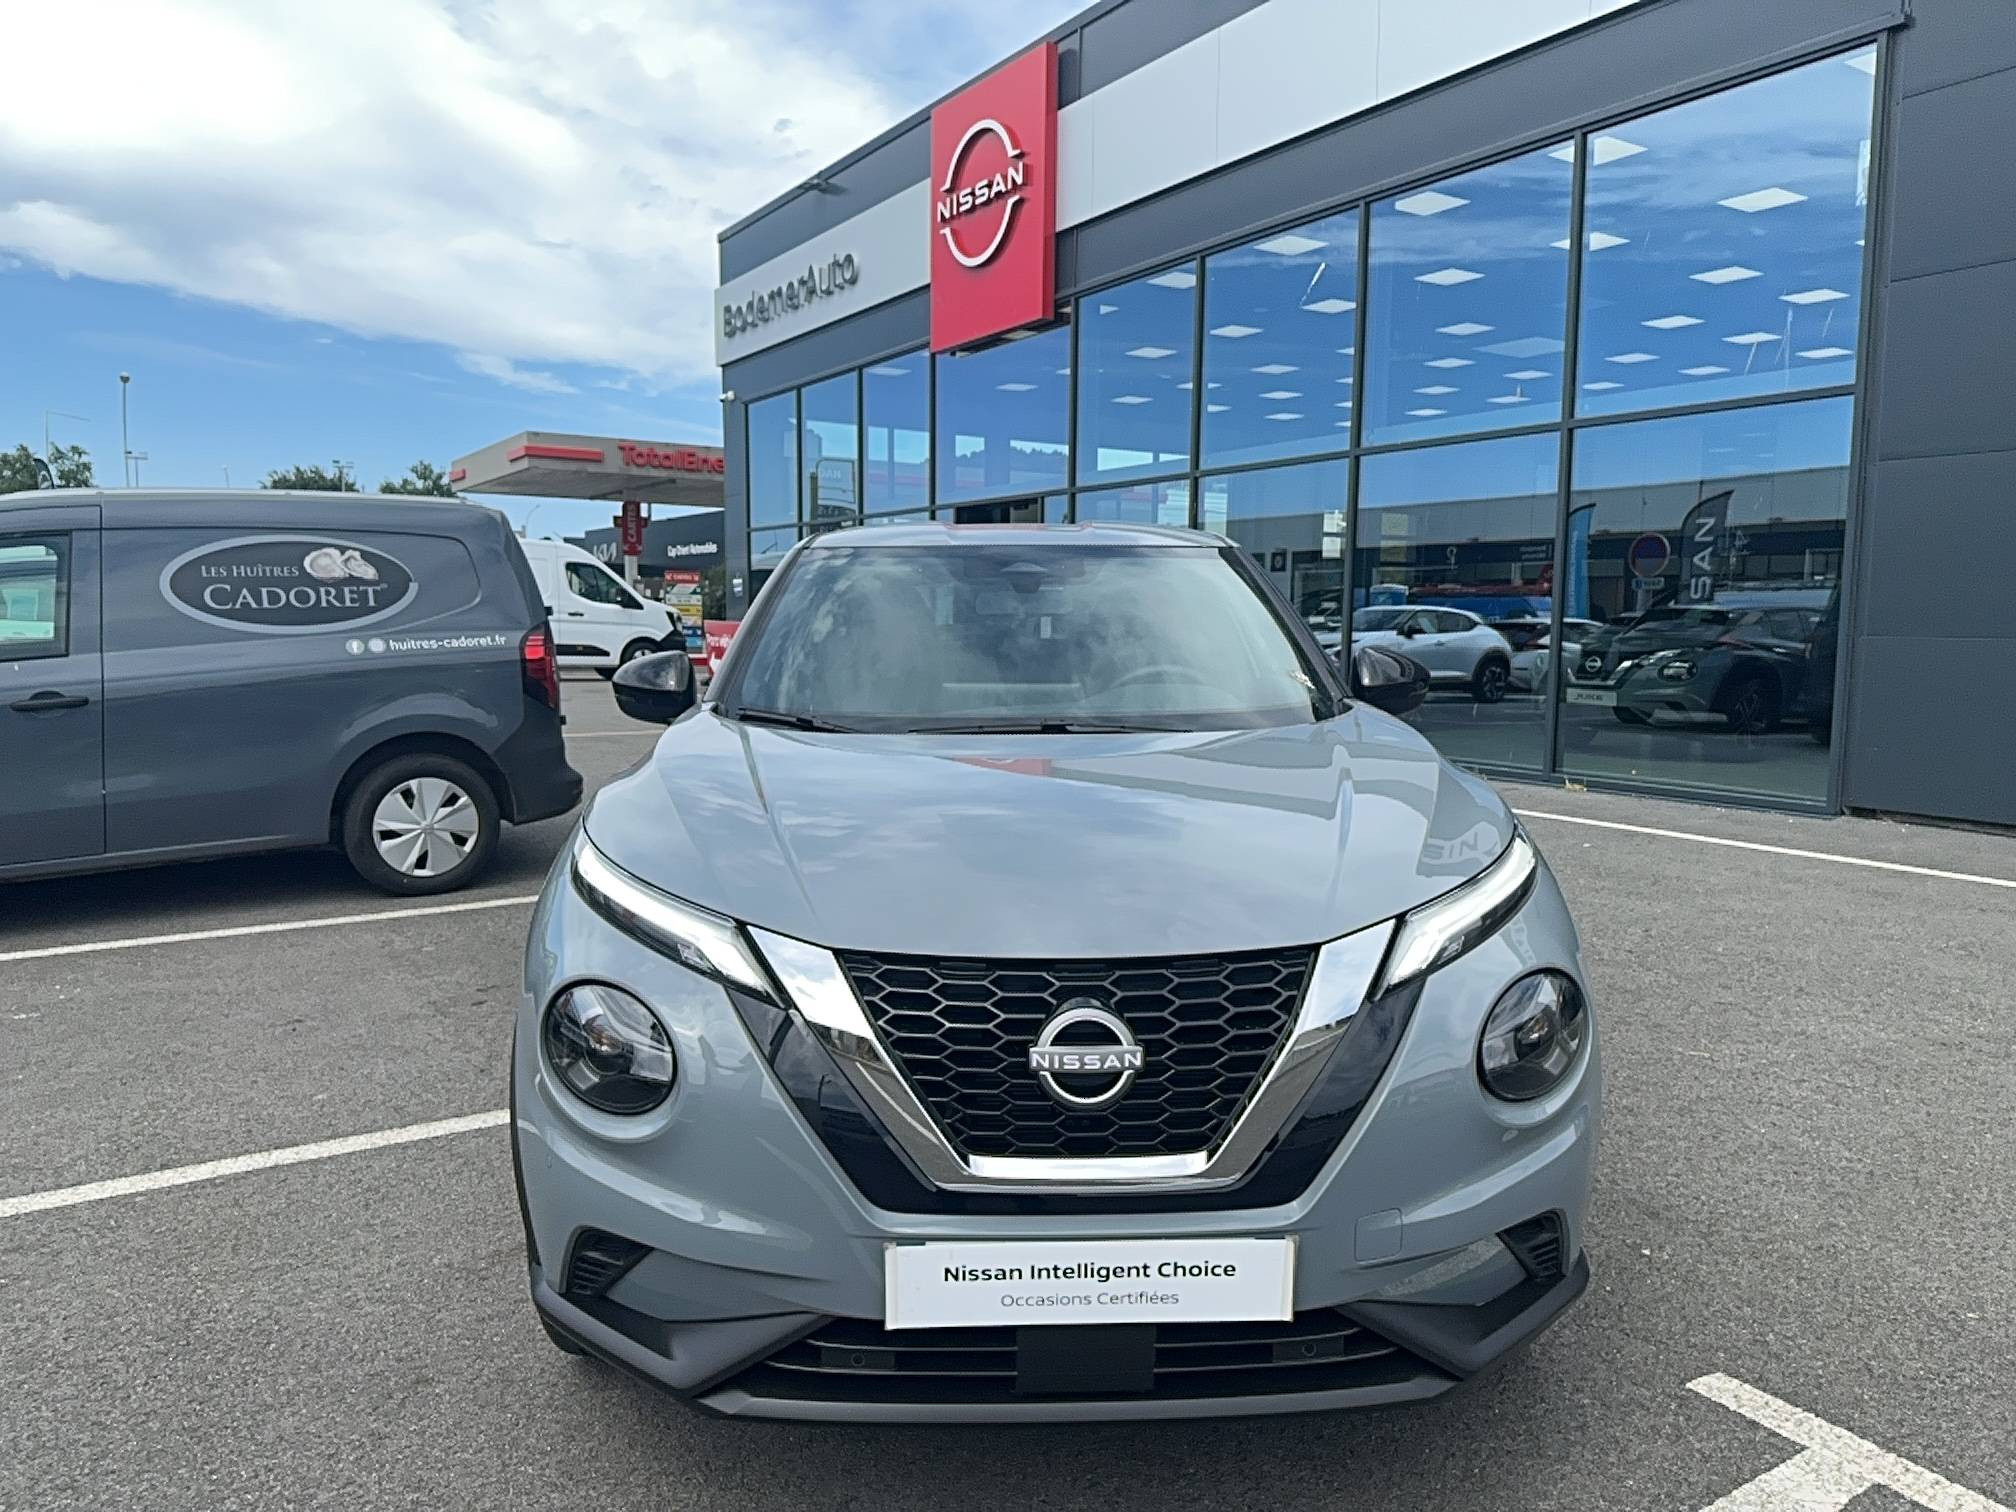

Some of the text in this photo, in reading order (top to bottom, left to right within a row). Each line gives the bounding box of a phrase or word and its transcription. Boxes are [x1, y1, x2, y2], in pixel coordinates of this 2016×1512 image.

[936, 161, 1025, 222] NISSAN
[201, 564, 227, 578] LES
[203, 583, 381, 610] CADORET
[1031, 1052, 1142, 1070] NISSAN
[943, 1260, 1237, 1283] Nissan Intelligent Choice
[1000, 1290, 1180, 1308] Occasions Certifiées
